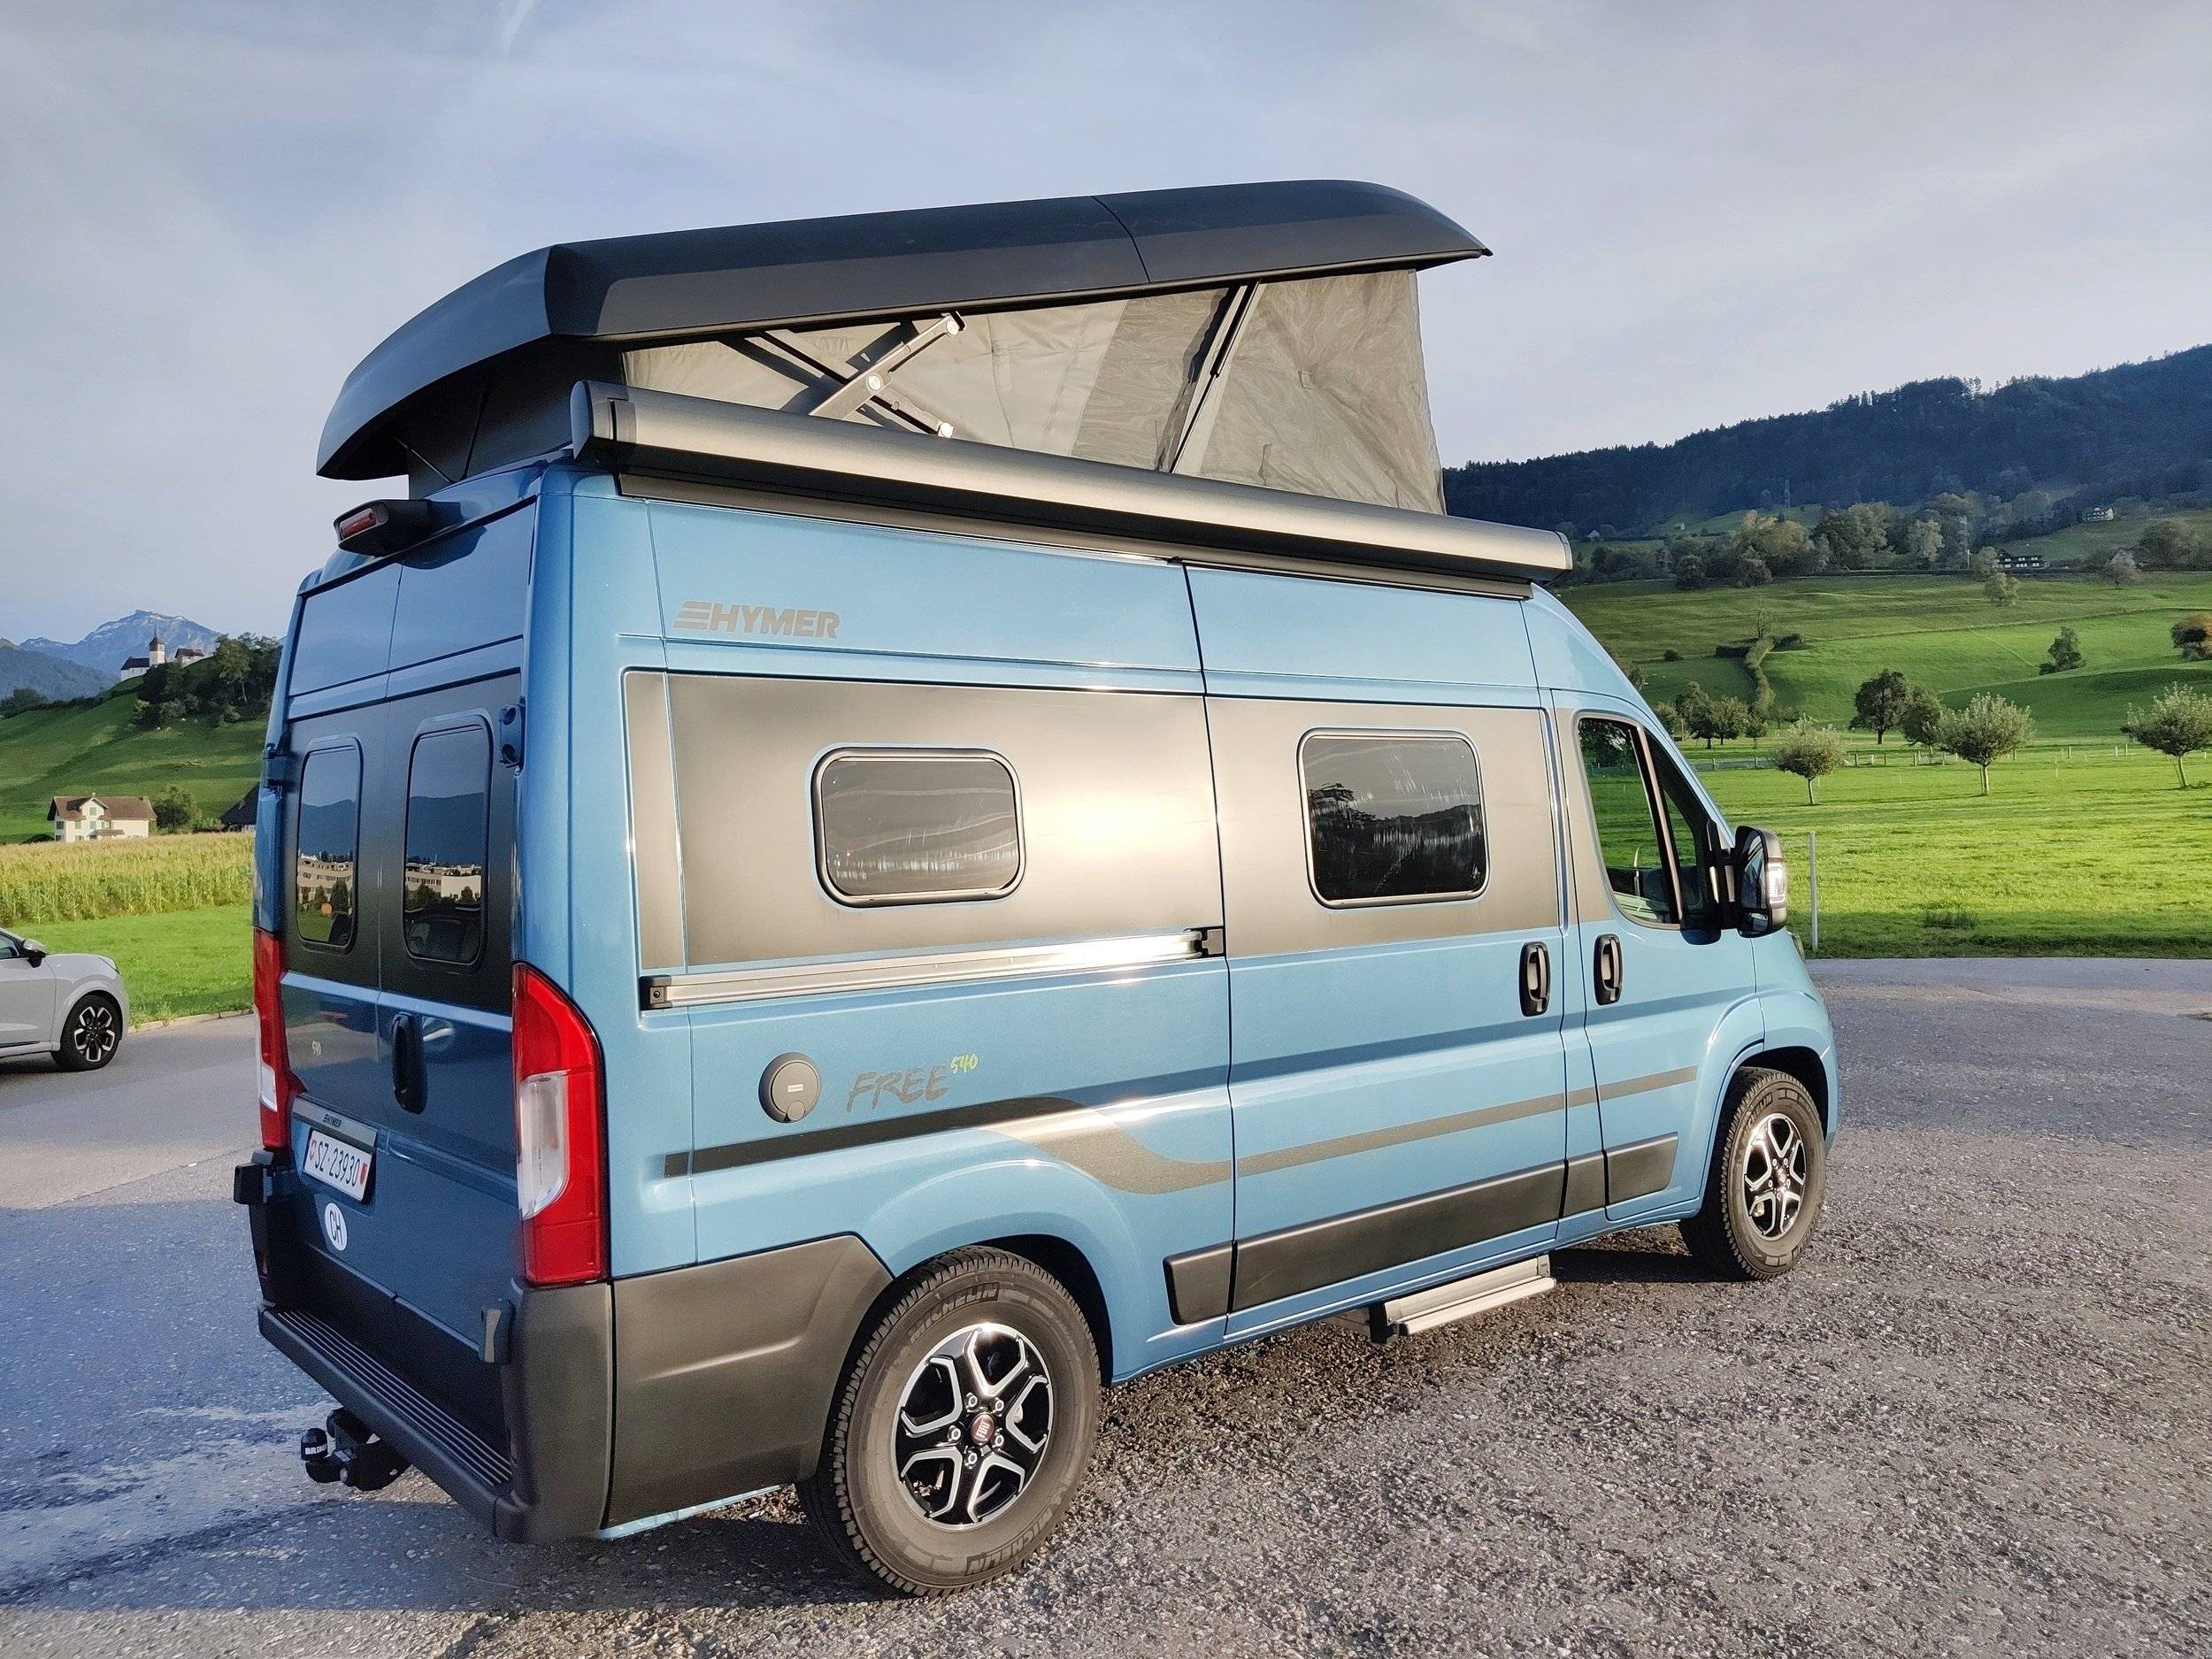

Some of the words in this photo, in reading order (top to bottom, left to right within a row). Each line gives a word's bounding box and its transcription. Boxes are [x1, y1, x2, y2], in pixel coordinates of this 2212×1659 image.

[709, 603, 840, 639] HYMER
[846, 1064, 949, 1112] FREE
[950, 1053, 979, 1074] 540
[329, 1210, 343, 1245] CH
[976, 1418, 990, 1439] FIAT
